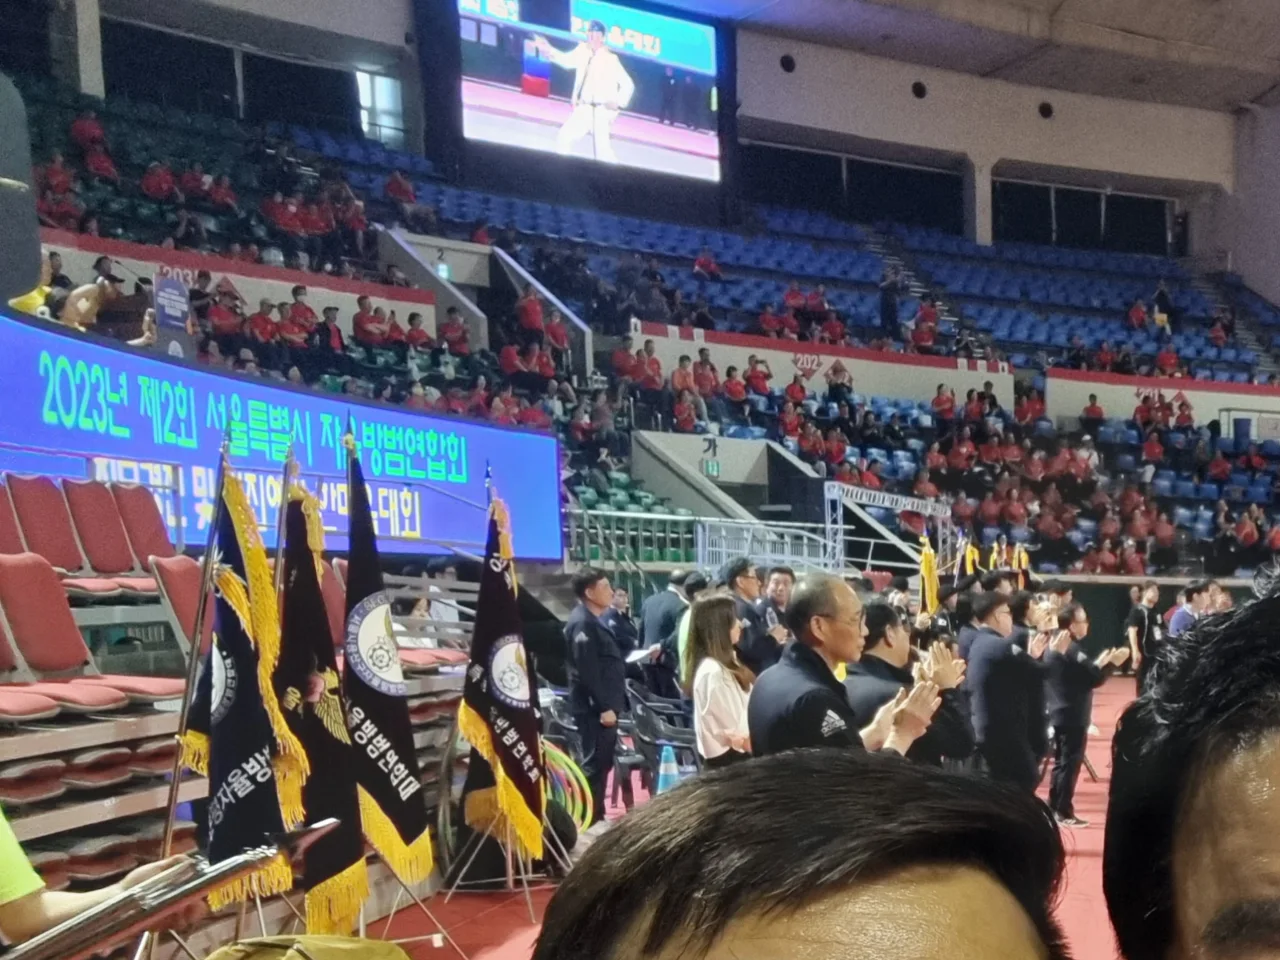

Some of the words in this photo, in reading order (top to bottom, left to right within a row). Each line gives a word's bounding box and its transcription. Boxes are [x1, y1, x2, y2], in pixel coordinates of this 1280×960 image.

[795, 353, 819, 369] 202
[39, 350, 131, 438] 2023년
[137, 375, 198, 449] 제2회
[206, 391, 313, 467] 서울특별시
[702, 437, 719, 457] 가
